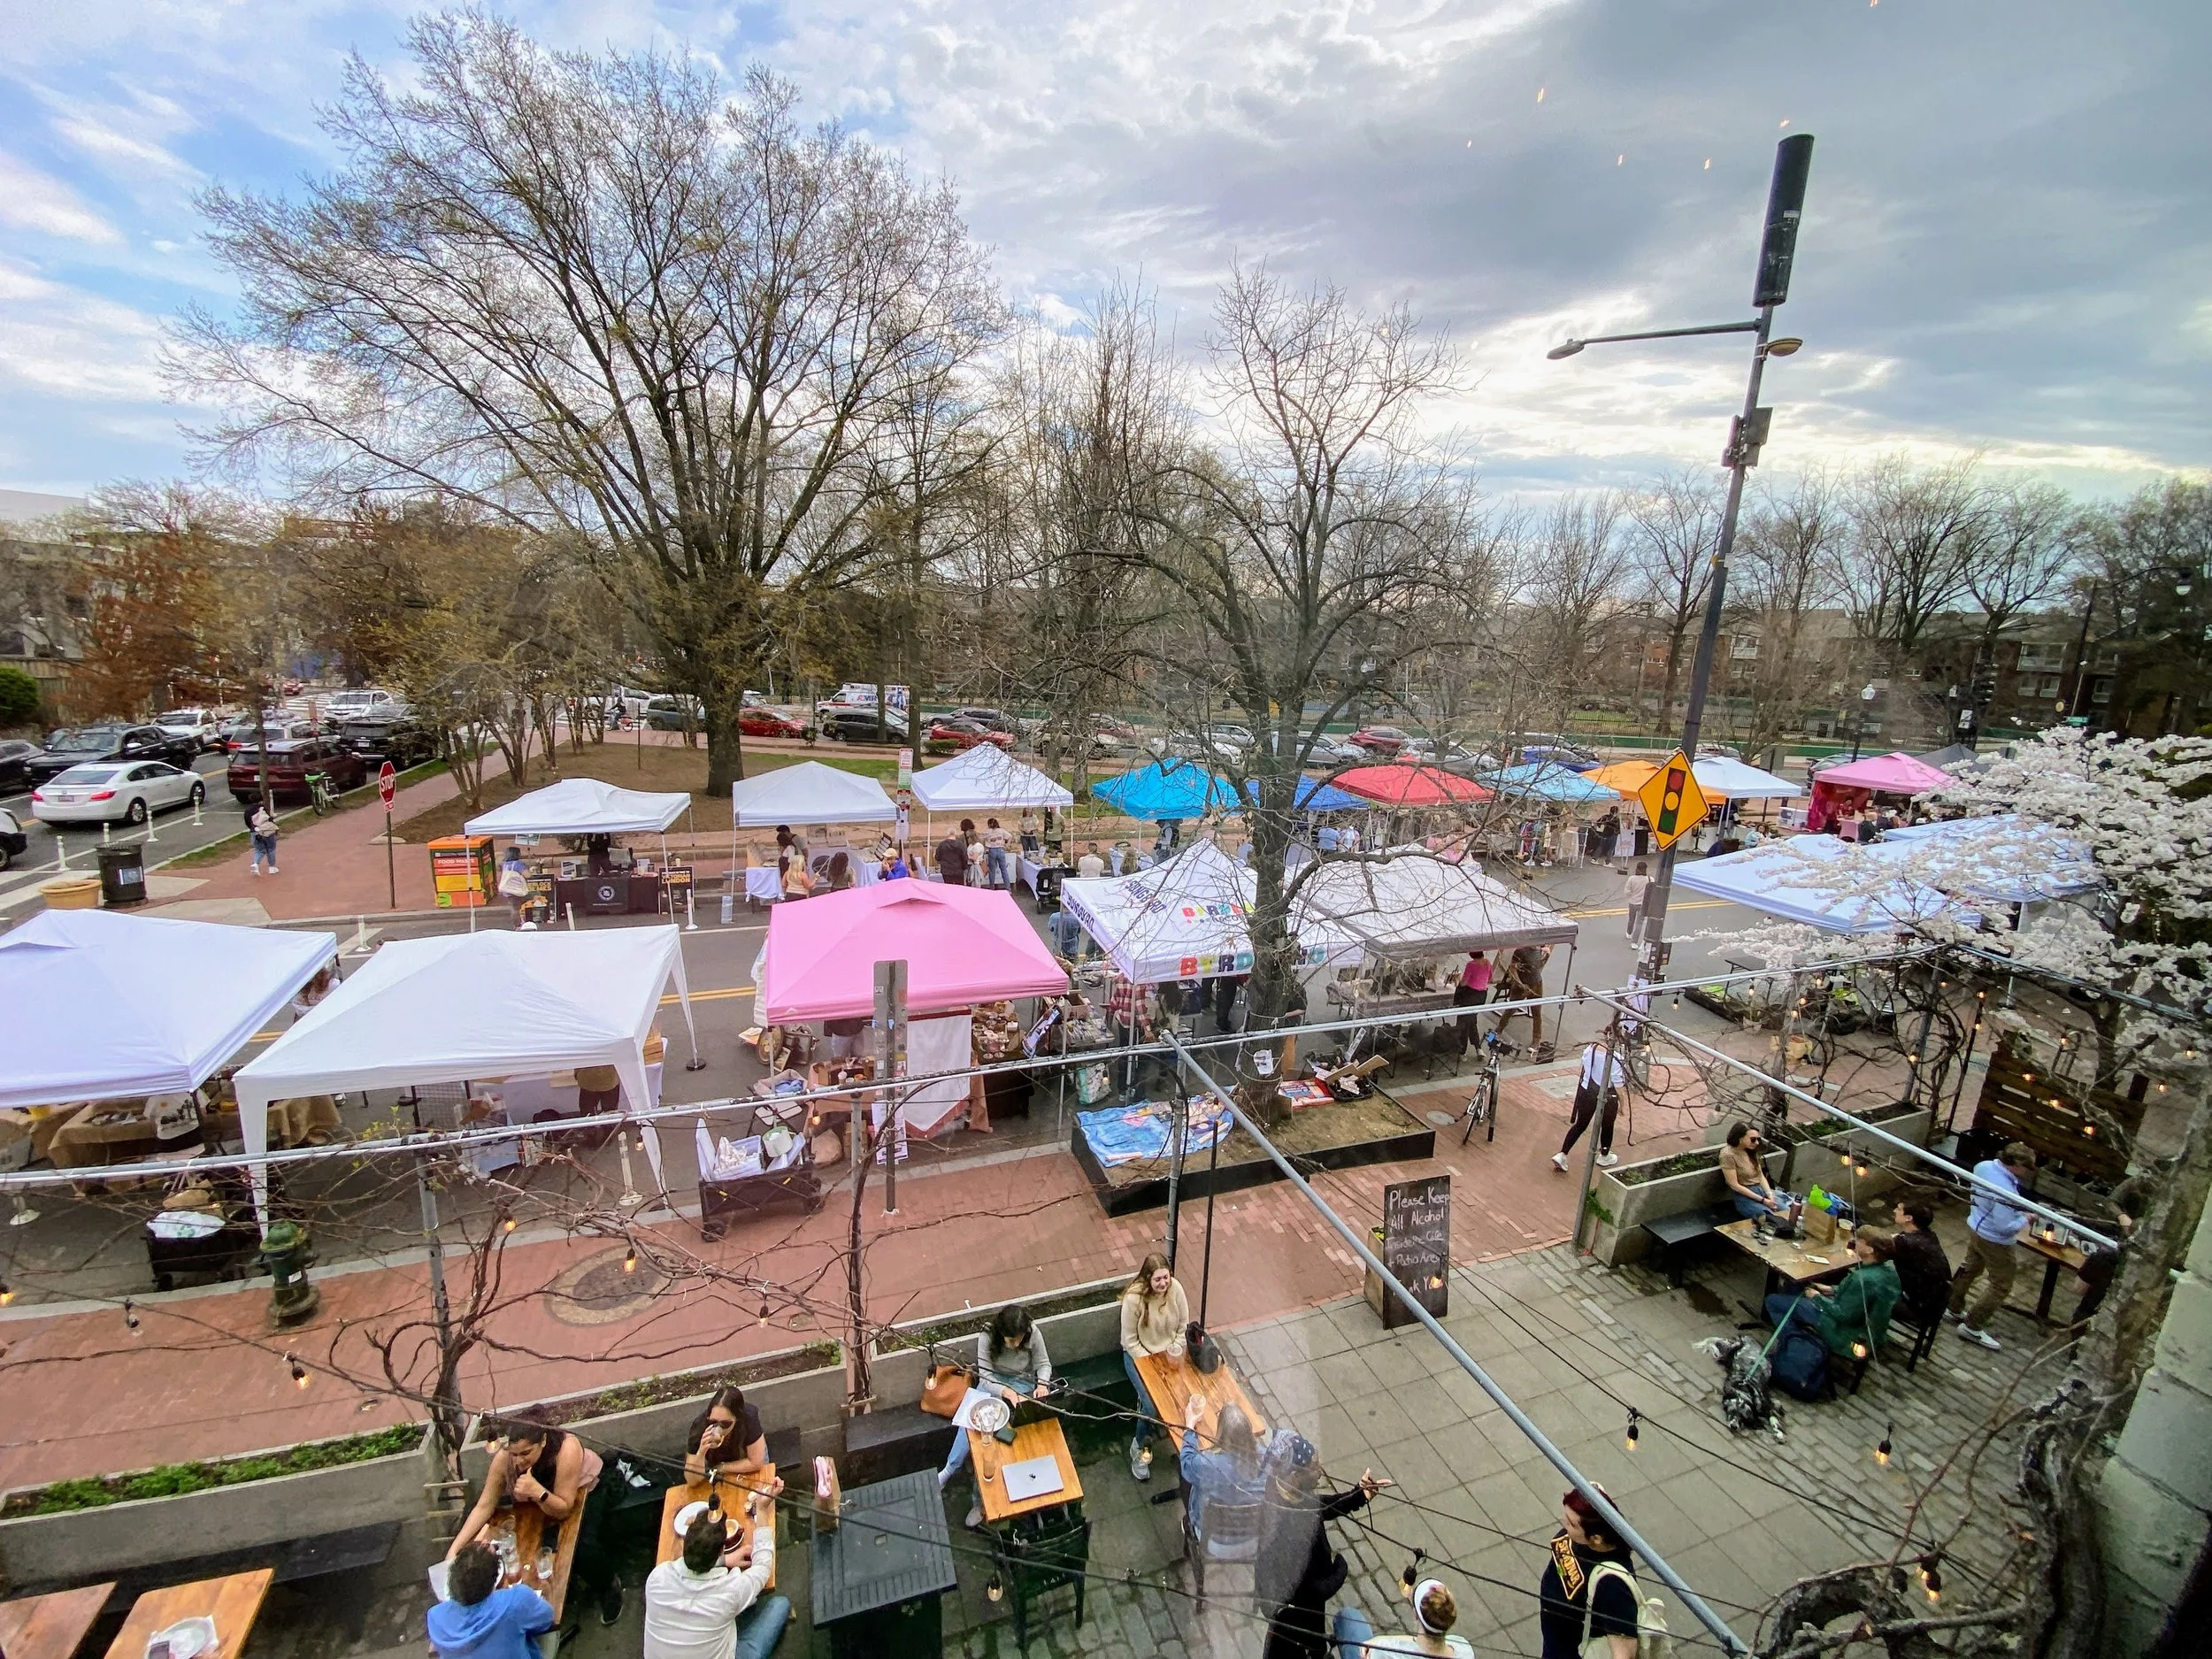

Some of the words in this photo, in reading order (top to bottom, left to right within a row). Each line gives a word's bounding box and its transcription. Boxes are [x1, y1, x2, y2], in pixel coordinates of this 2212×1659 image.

[380, 773, 395, 792] STOP
[1389, 1189, 1425, 1210] Please
[1427, 1187, 1449, 1205] Keep
[1390, 1214, 1403, 1233] All
[1411, 1207, 1444, 1225] Alcohol
[1396, 1254, 1419, 1266] Patio
